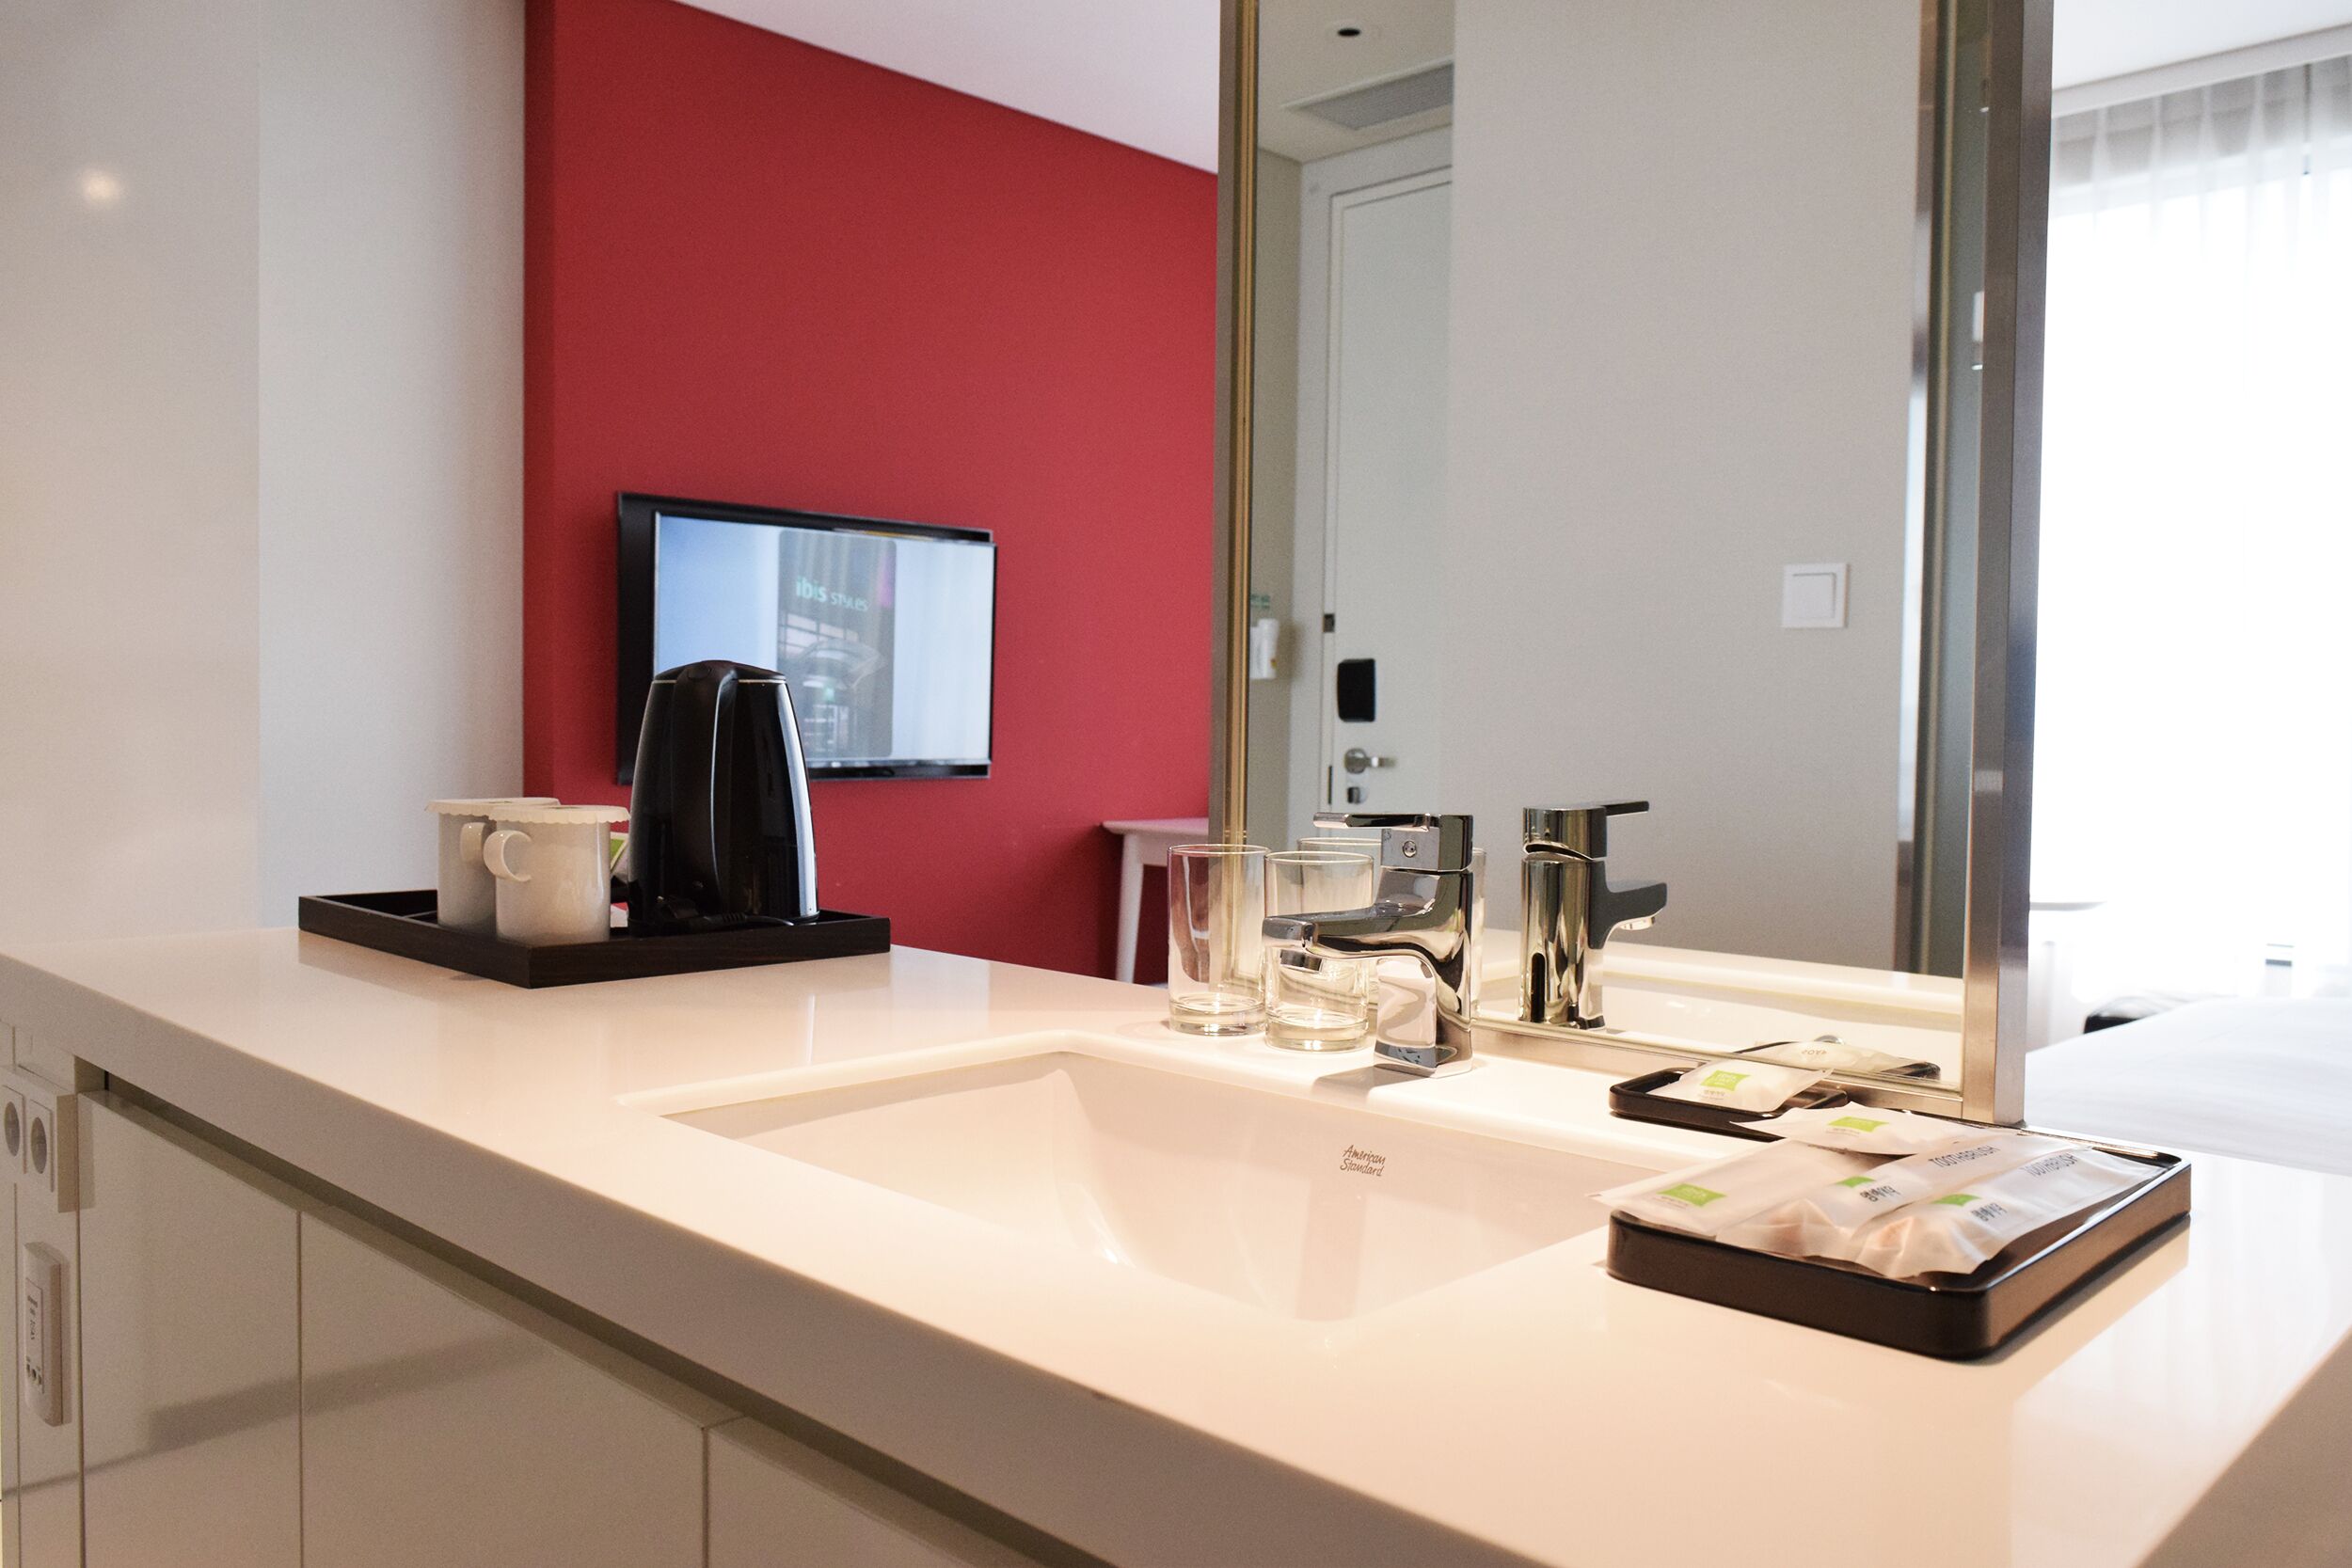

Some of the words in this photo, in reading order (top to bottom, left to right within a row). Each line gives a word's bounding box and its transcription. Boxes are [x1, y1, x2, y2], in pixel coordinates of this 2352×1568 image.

[796, 576, 828, 602] ibis
[1343, 1144, 1386, 1164] American
[1928, 1145, 2000, 1167] TOOTHBRUSH
[2020, 1152, 2078, 1177] TOOTHBRUSH
[1340, 1158, 1385, 1177] Standard
